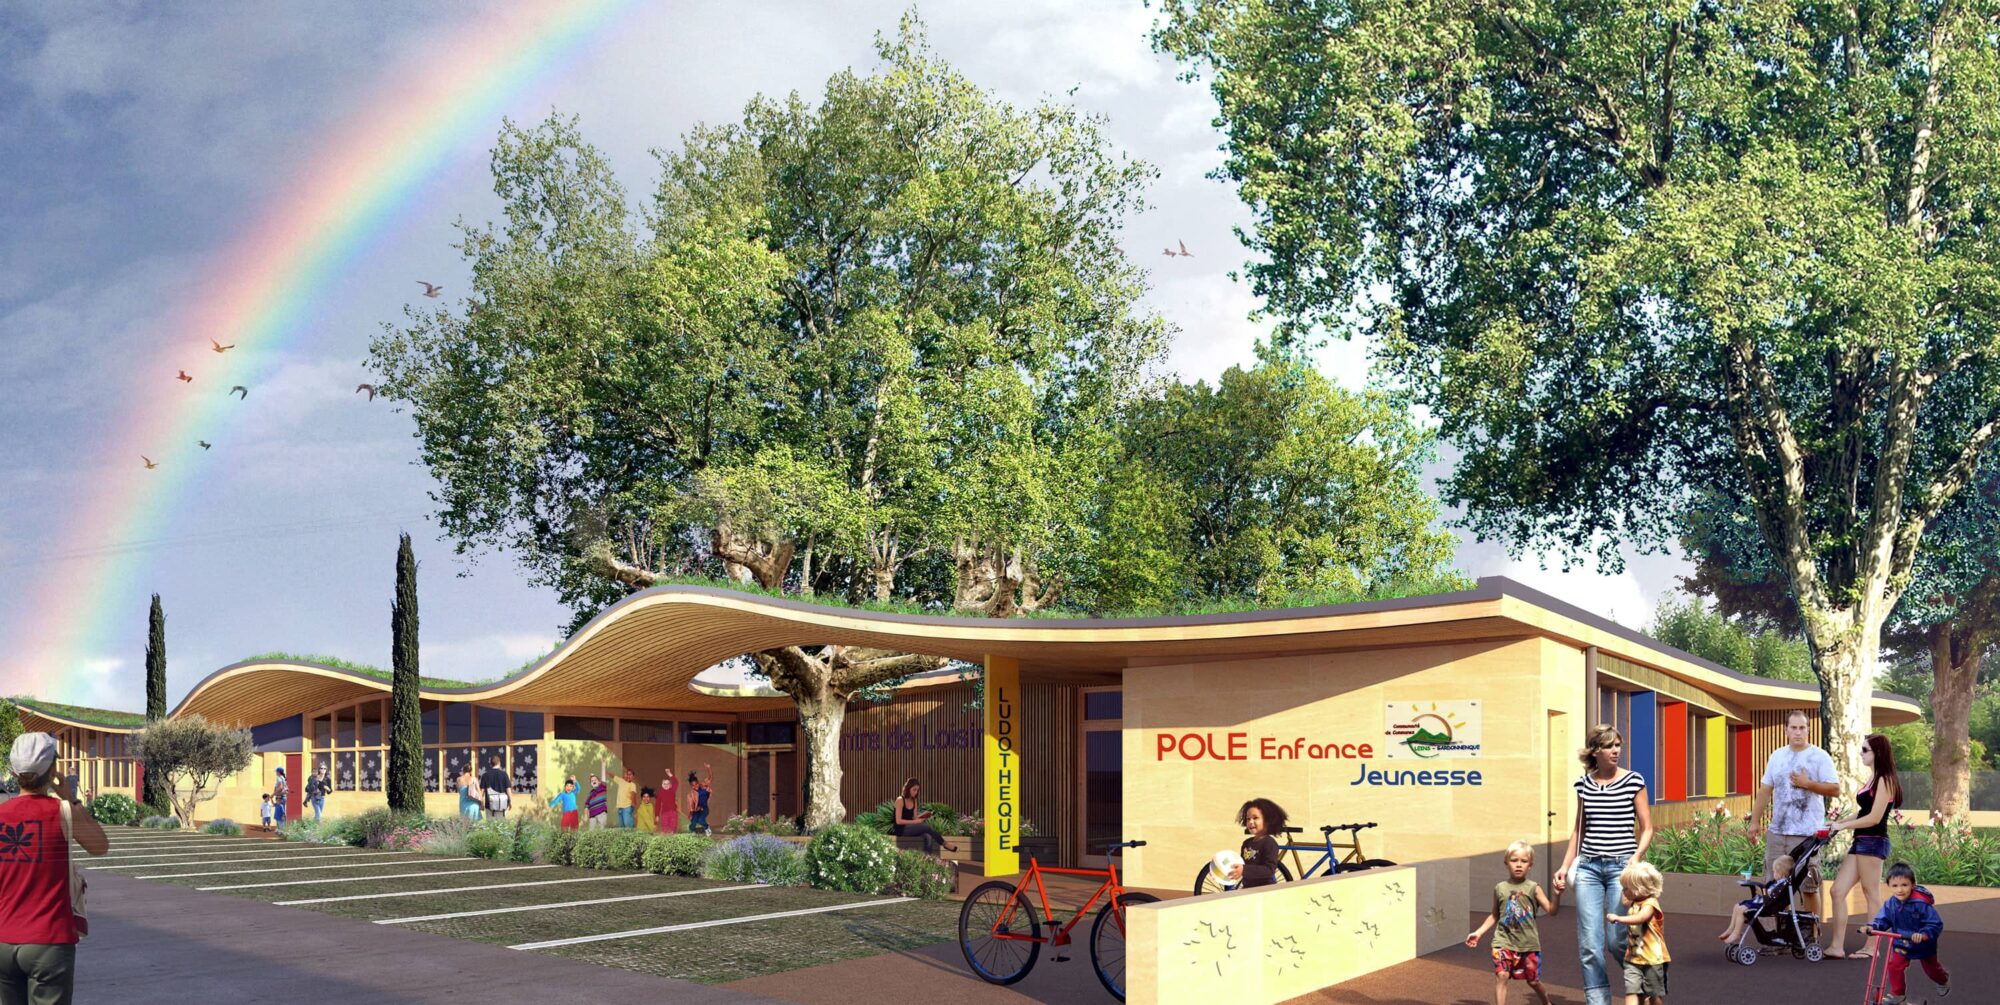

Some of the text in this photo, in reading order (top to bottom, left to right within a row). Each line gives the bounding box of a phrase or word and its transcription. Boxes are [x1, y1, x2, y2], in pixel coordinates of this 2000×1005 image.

[840, 727, 880, 751] ntre
[887, 724, 914, 751] de
[1157, 733, 1373, 761] POLE Enfance
[998, 687, 1012, 850] LUDOTHEQUE
[1350, 764, 1483, 786] Jeunesse
